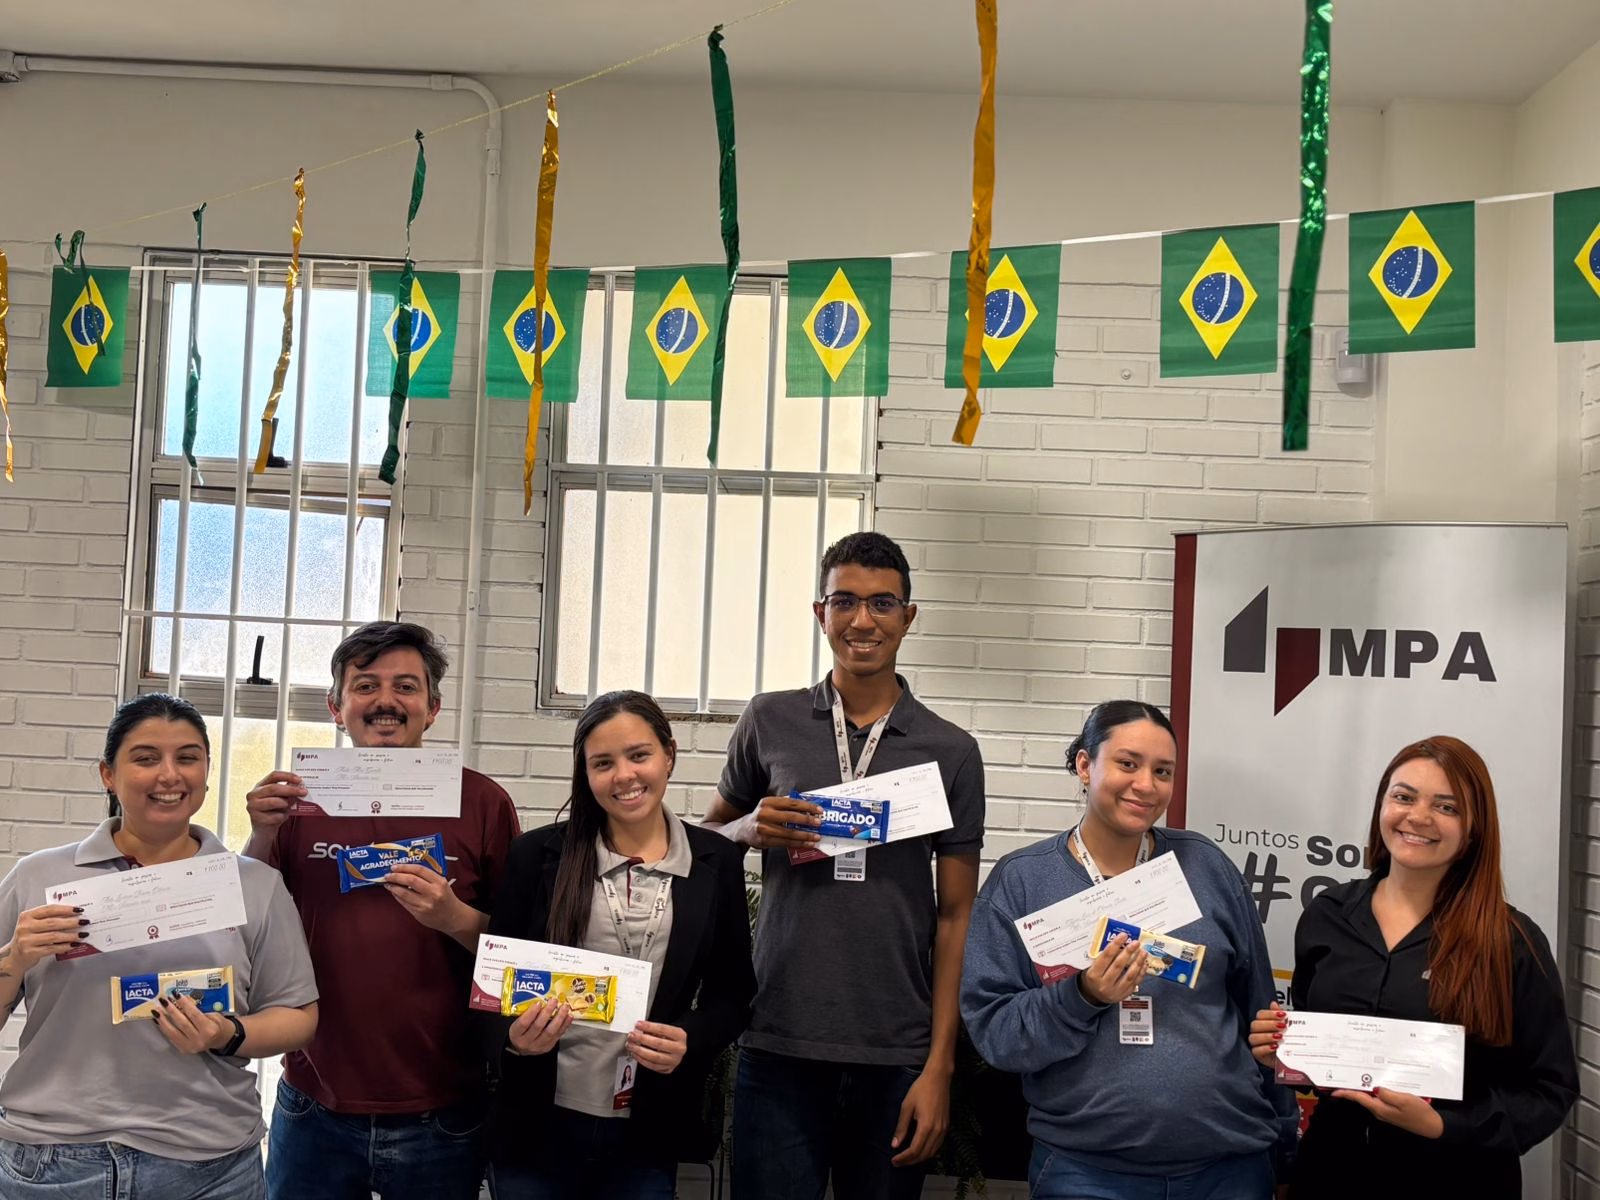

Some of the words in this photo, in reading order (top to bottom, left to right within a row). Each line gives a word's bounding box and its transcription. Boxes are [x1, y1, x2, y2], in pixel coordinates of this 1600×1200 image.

[1329, 628, 1497, 682] MPA
[820, 810, 876, 826] BRIGADO
[350, 849, 369, 859] LACTA
[1214, 824, 1299, 849] Juntos
[1306, 835, 1371, 870] So
[378, 850, 399, 860] VALE
[360, 855, 422, 871] AGRADECIMENTO
[62, 890, 78, 898] MPA
[516, 980, 545, 992] LACTA
[125, 987, 154, 1001] LACTA
